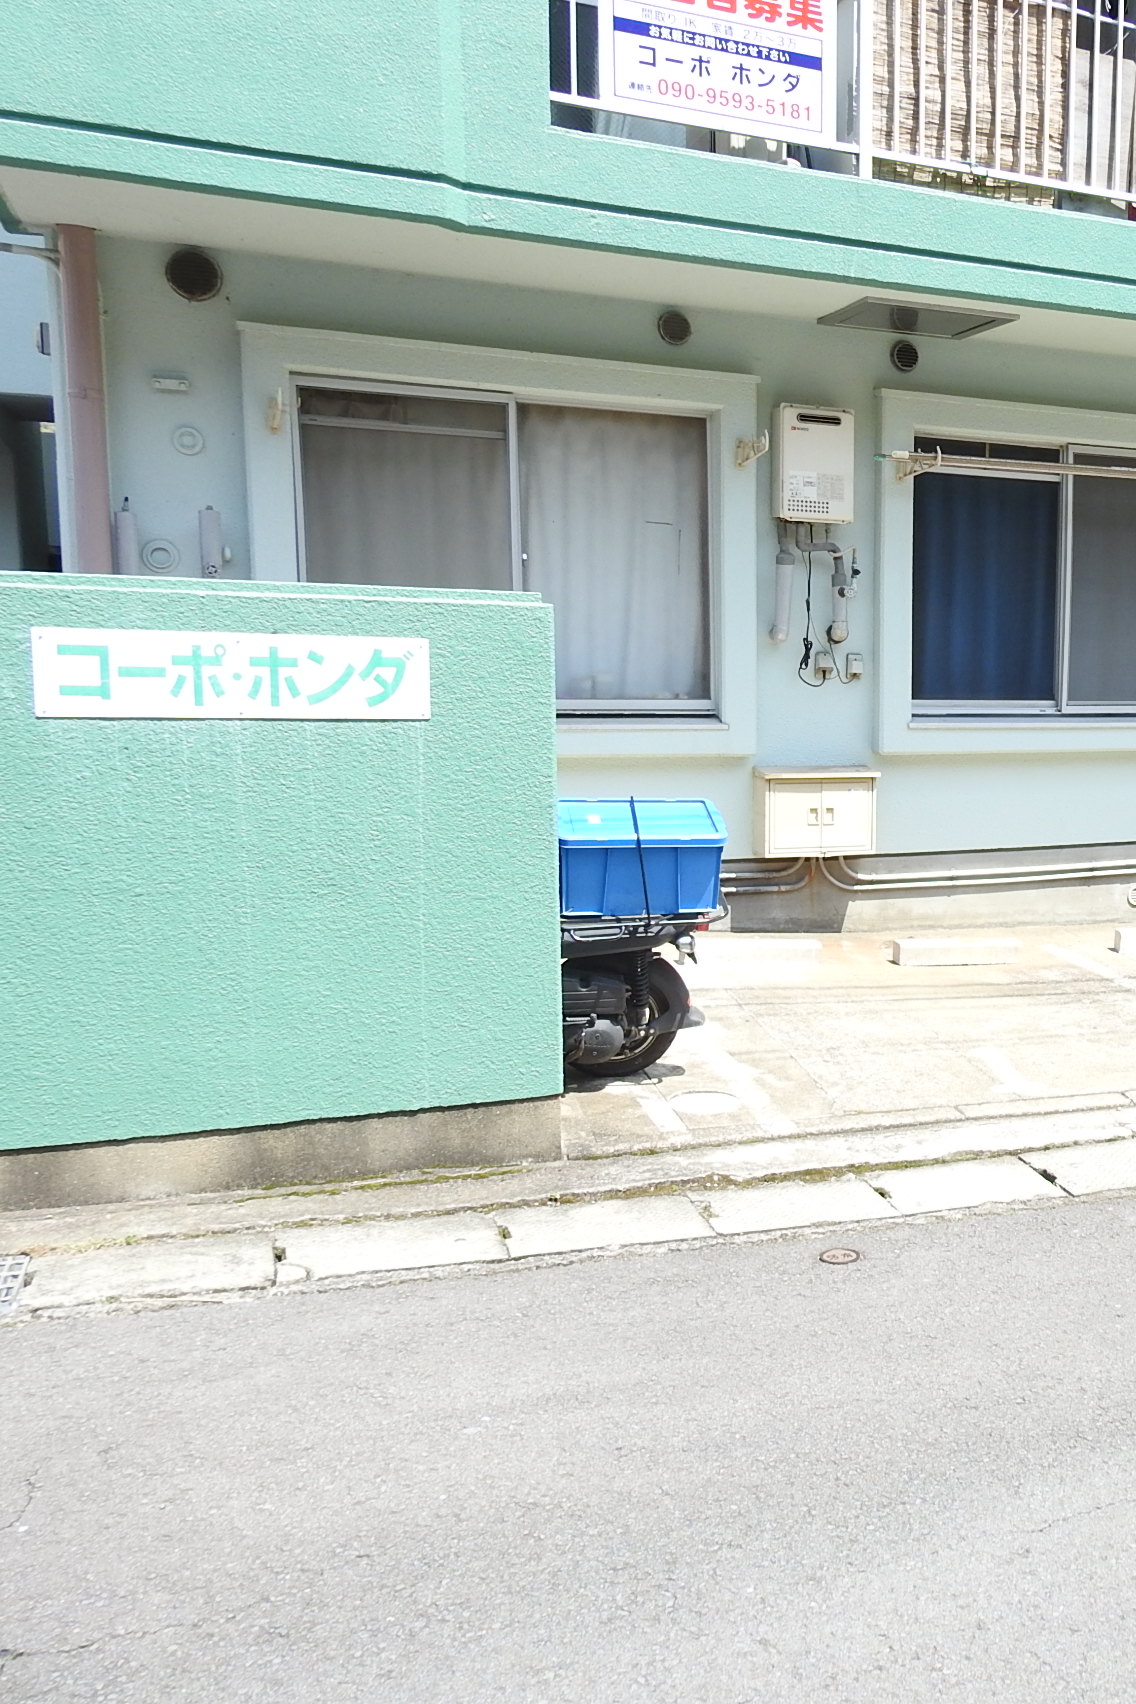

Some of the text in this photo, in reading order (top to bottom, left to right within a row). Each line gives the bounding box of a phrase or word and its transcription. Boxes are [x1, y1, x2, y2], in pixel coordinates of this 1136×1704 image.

[638, 45, 801, 93] コーポ ホンダ
[657, 79, 812, 121] 090-9593-5181
